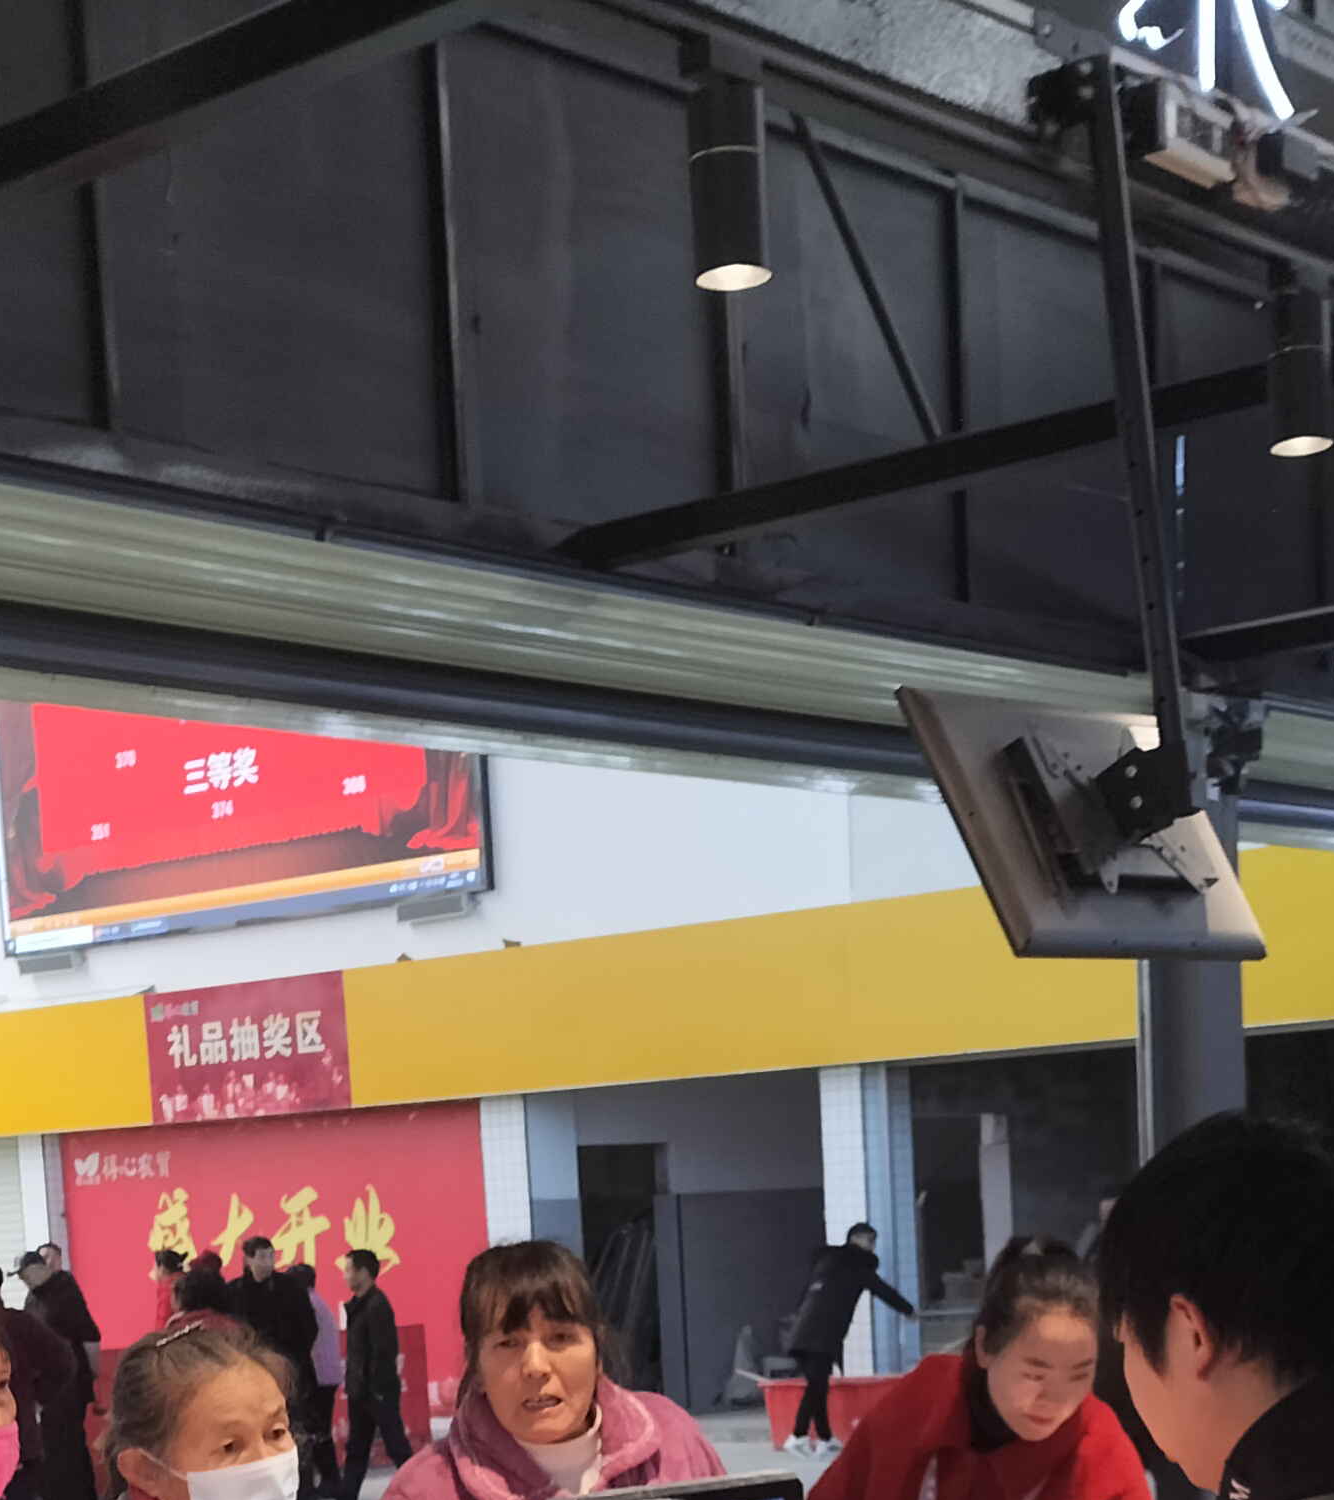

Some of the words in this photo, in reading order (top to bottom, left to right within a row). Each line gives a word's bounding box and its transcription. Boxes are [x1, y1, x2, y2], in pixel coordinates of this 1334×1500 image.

[182, 746, 259, 795] 三等奖
[167, 1010, 325, 1069] 礼品抽奖区
